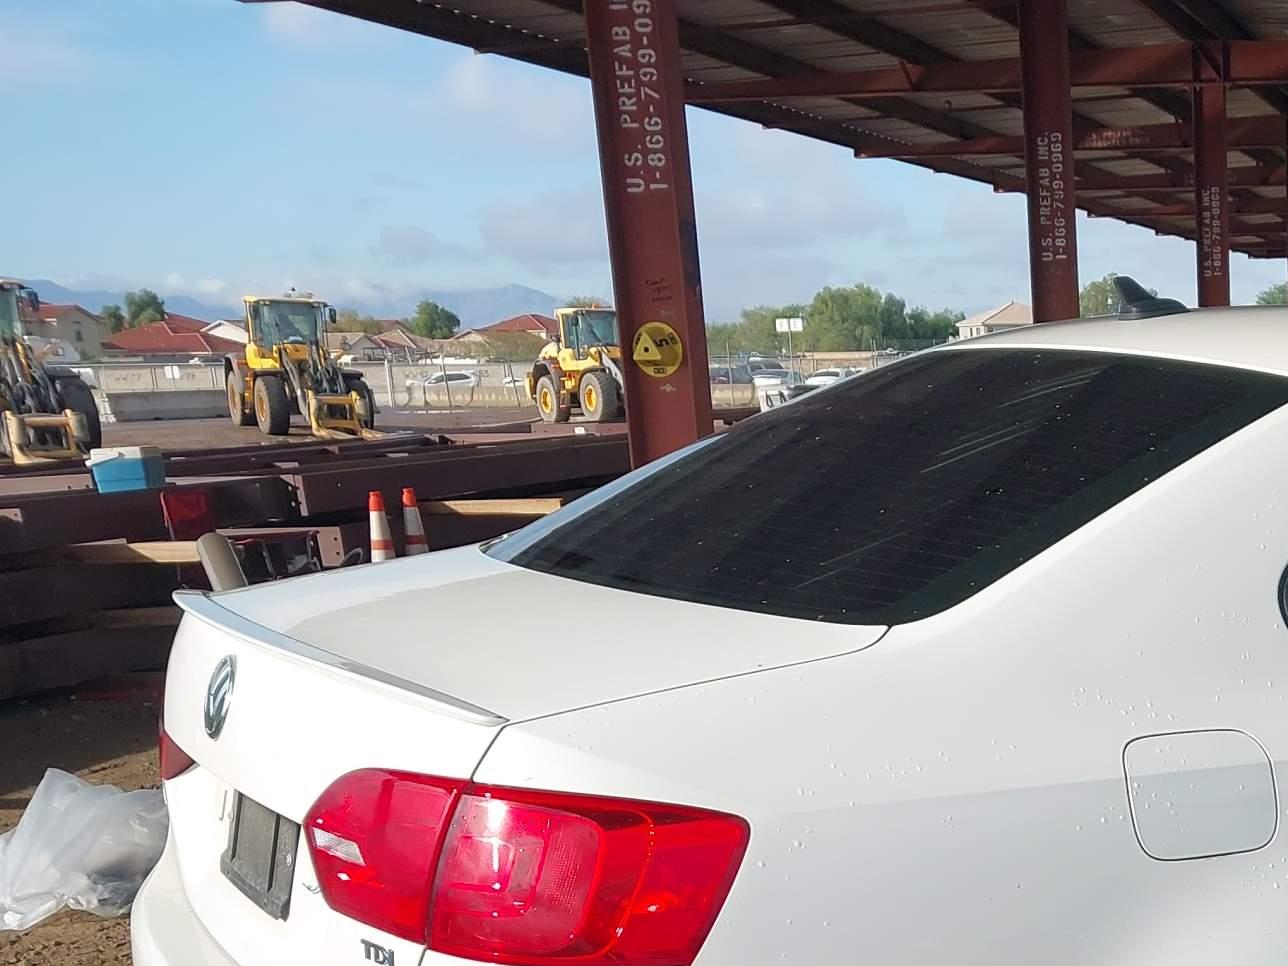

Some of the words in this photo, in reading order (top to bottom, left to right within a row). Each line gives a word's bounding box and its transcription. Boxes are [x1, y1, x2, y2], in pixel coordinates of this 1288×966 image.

[611, 25, 640, 128] PREFAB
[624, 144, 646, 194] U.S.
[1037, 131, 1049, 160] INC.
[1038, 167, 1052, 225] PREFAB
[1050, 132, 1068, 260] 1-866-799-0969
[1041, 233, 1054, 262] U.S.
